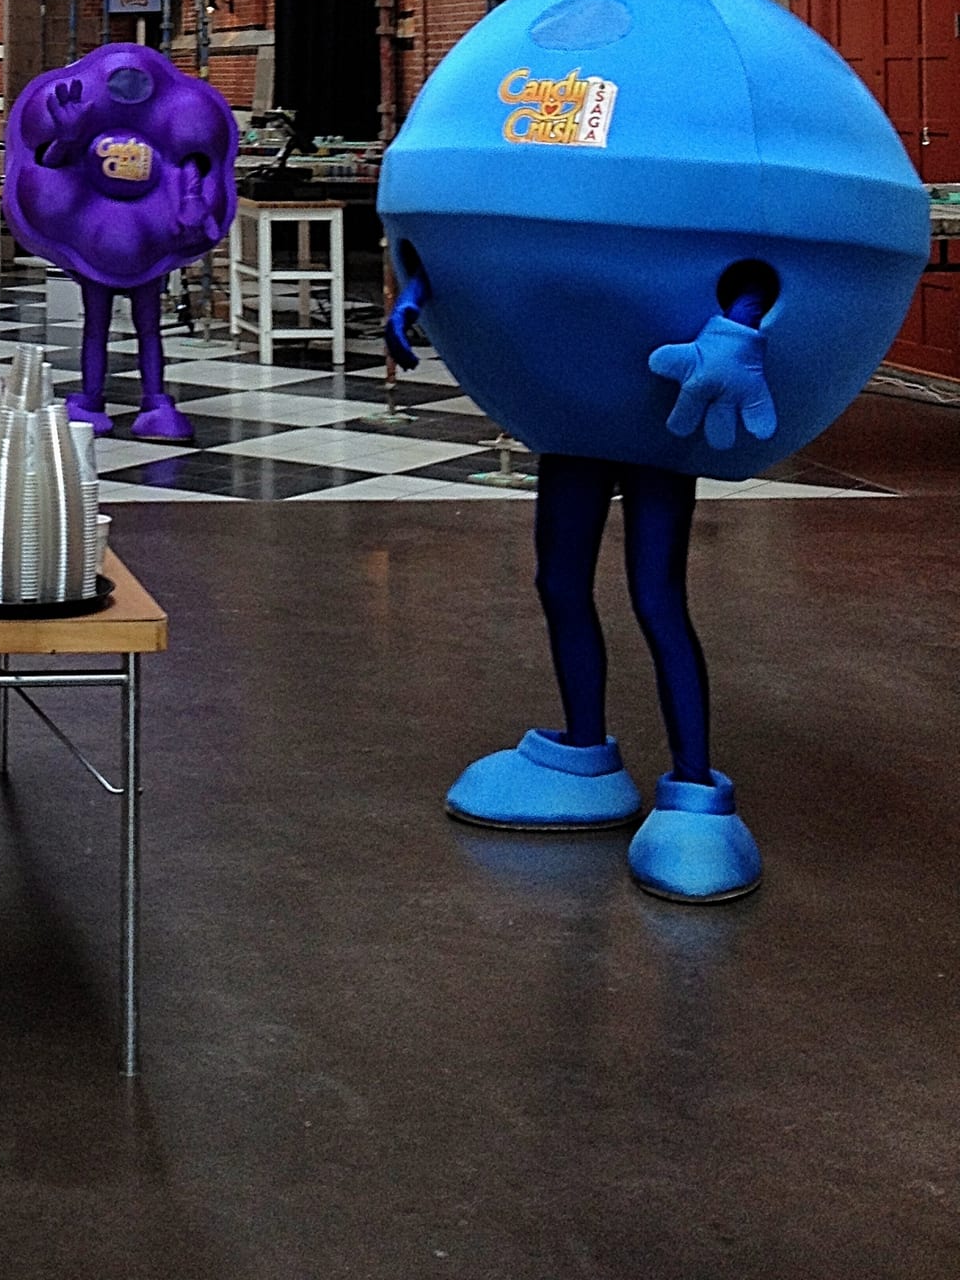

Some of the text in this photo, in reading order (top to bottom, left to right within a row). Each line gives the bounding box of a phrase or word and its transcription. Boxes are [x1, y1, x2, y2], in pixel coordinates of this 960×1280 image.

[499, 67, 589, 108] Candy
[504, 108, 580, 144] Crush
[584, 90, 606, 140] SAGA
